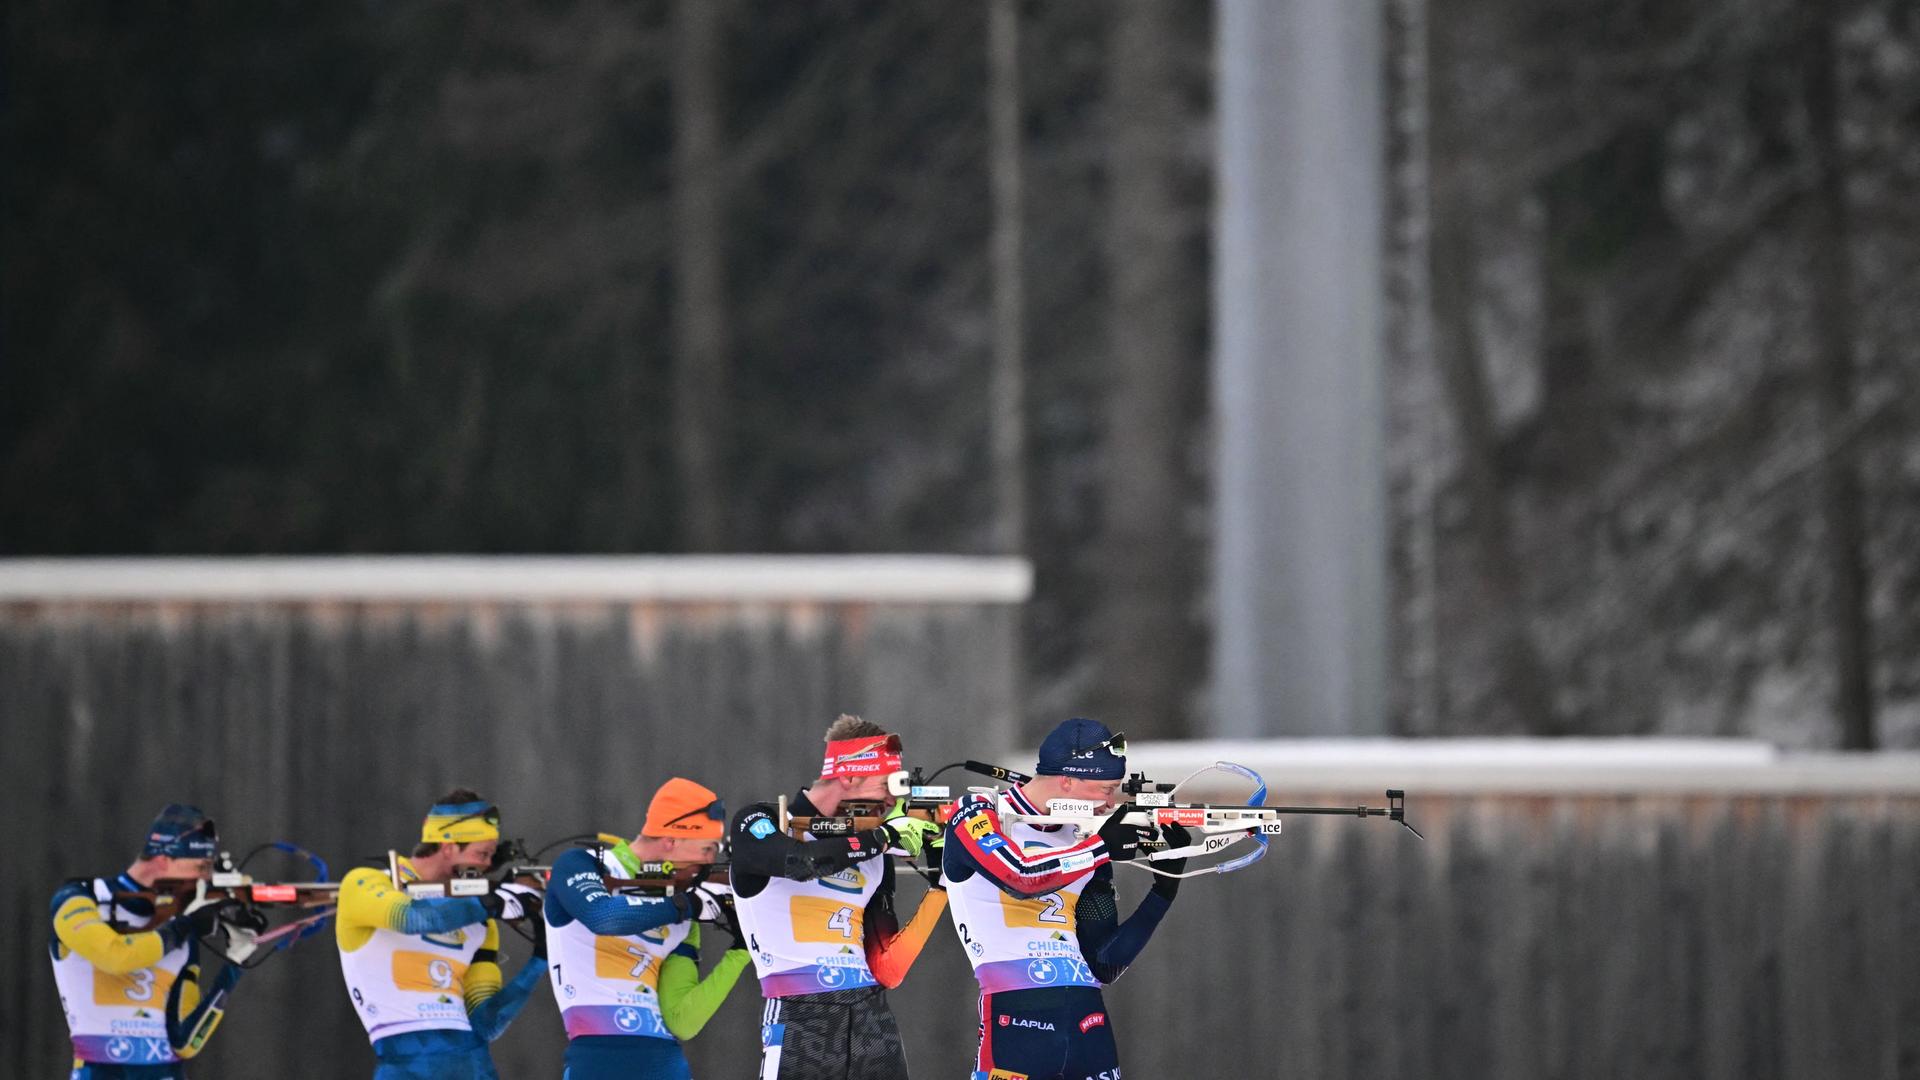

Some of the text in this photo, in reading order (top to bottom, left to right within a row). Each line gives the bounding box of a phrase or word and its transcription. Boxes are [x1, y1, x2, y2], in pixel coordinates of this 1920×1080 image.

[846, 764, 880, 772] TERREX
[951, 802, 985, 826] CRAFT
[643, 864, 661, 872] ETIS
[1038, 892, 1067, 923] 2
[828, 906, 854, 938] 4
[750, 933, 760, 953] 4
[959, 923, 971, 944] 2
[627, 946, 654, 978] 7
[124, 967, 155, 1001] 3
[428, 959, 452, 989] 9
[553, 964, 562, 986] 7
[353, 987, 364, 1006] 9
[1012, 1018, 1055, 1031] LAPUA
[1081, 1015, 1103, 1030] MENY
